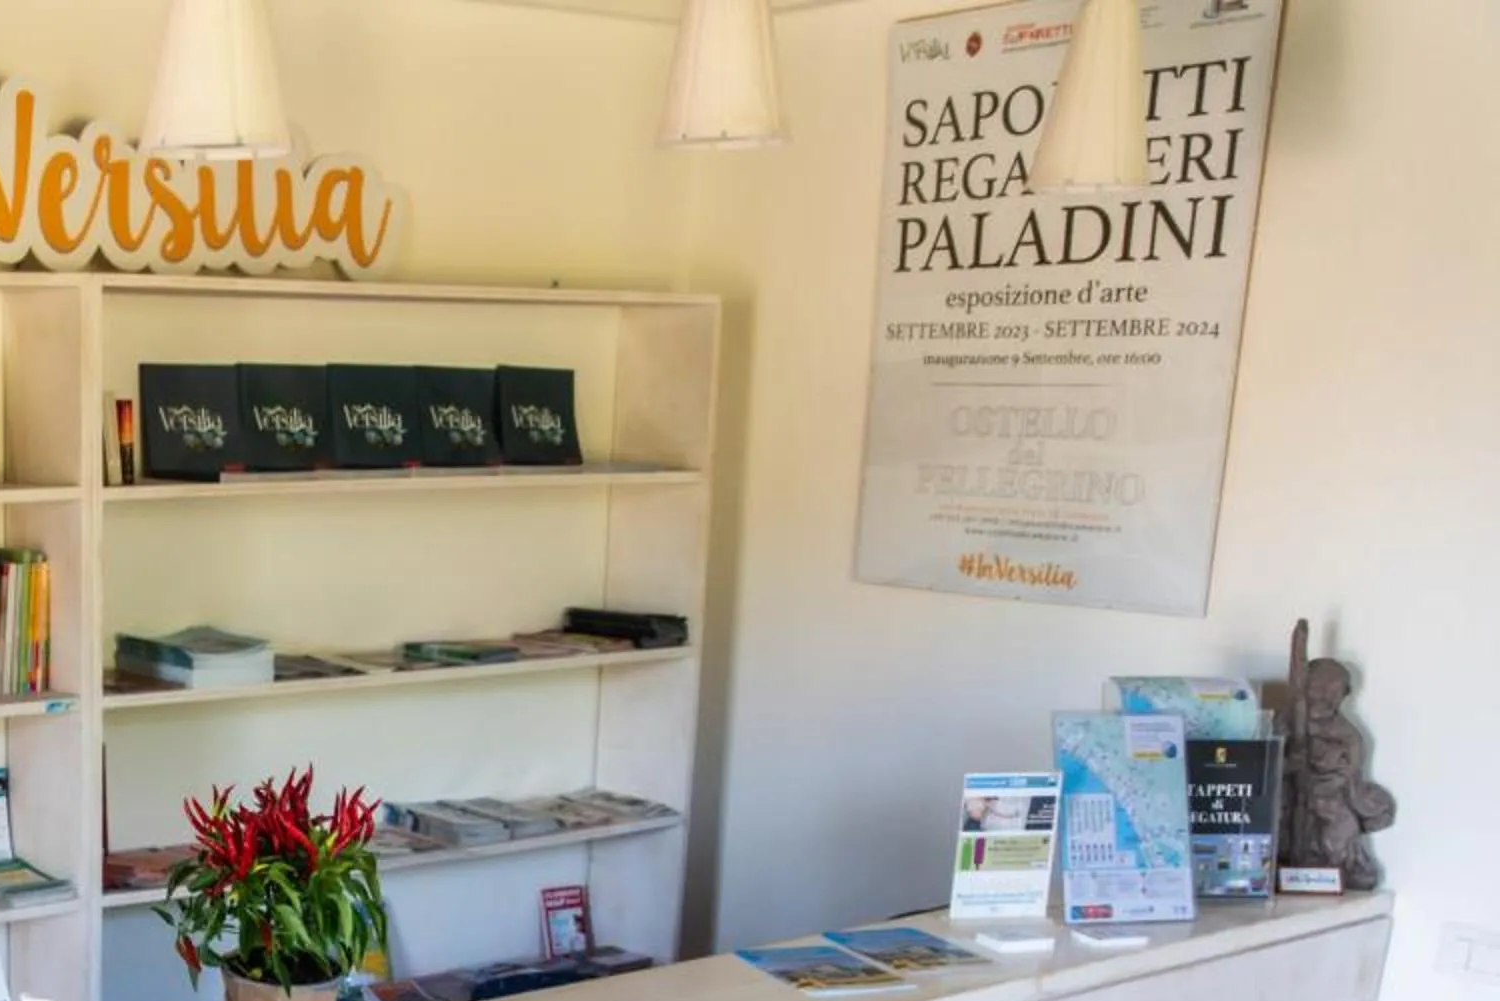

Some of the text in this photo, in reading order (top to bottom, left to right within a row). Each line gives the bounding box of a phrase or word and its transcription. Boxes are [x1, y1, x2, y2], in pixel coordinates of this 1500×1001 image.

[902, 56, 1251, 147] SAPOTTI
[899, 128, 1244, 206] REGAERI
[894, 195, 1235, 273] PALADINI
[946, 280, 1148, 314] esposizione d'arte
[886, 321, 990, 341] SETTEMBRE
[994, 325, 1030, 342] 2023
[1044, 319, 1171, 338] SETTEMBRE
[1175, 319, 1221, 339] 2024
[1188, 811, 1252, 824] EGATURA
